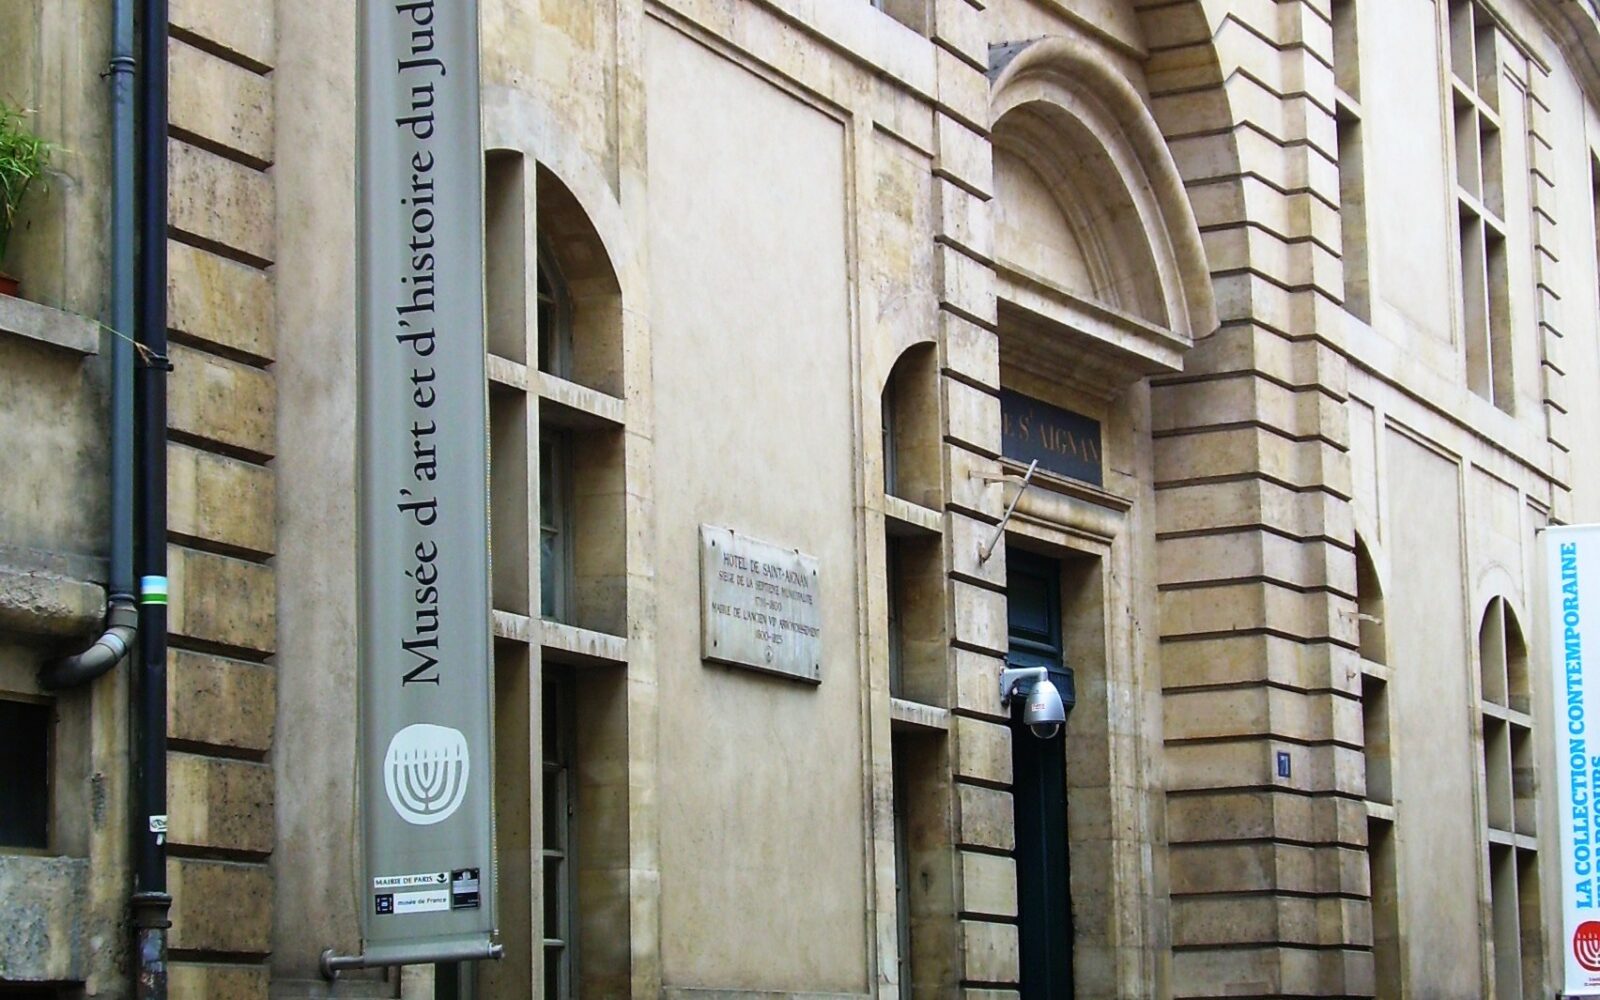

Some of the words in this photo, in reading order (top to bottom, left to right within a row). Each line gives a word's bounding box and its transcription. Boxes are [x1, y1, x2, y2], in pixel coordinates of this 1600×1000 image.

[395, 0, 445, 76] Jud
[396, 83, 434, 139] du
[396, 151, 435, 356] d'histoire
[411, 368, 436, 408] et
[1039, 424, 1099, 463] AIGNAN
[397, 421, 437, 525] d'art
[750, 560, 760, 575] DE
[402, 541, 439, 687] Musée
[733, 607, 741, 619] DE
[1560, 542, 1585, 735] CONTEMPORAINE
[1569, 738, 1592, 876] COLLECTION
[375, 878, 401, 886] MAIRIE
[413, 875, 433, 883] PARIS
[1575, 879, 1593, 909] LA
